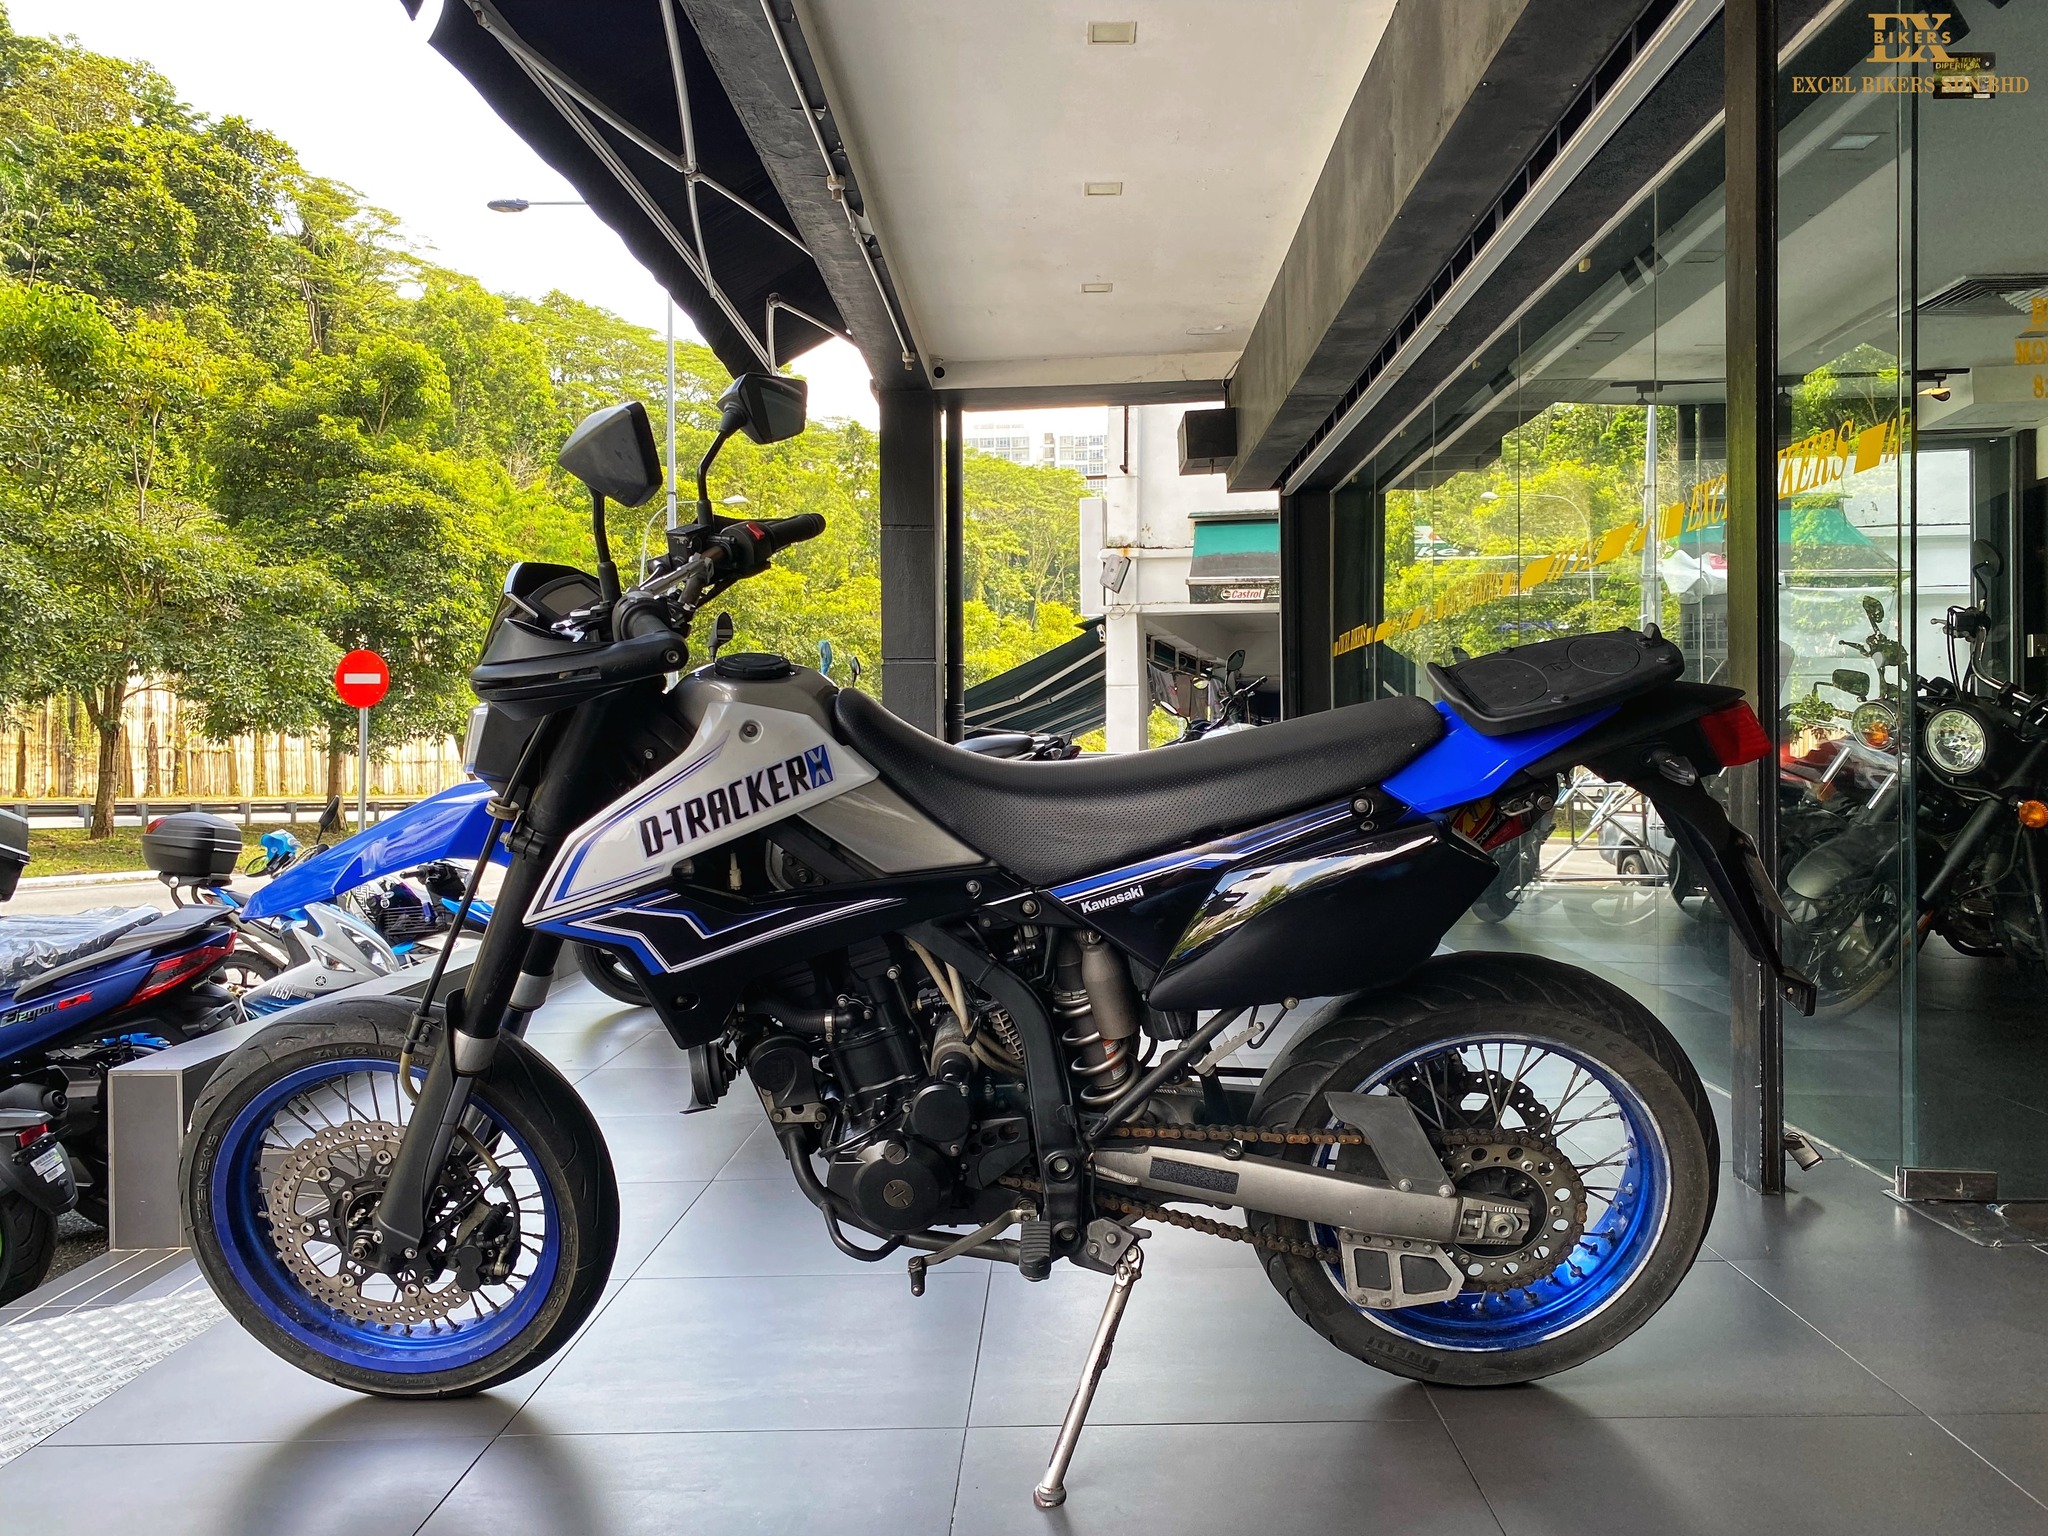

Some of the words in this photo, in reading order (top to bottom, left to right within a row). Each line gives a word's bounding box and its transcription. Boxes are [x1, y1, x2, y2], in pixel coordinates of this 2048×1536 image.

[2015, 341, 2048, 365] MO
[1686, 473, 1728, 532] EXC
[1777, 418, 1856, 500] KERS
[1231, 590, 1263, 599] Castrol
[1080, 884, 1145, 914] Kawasaki
